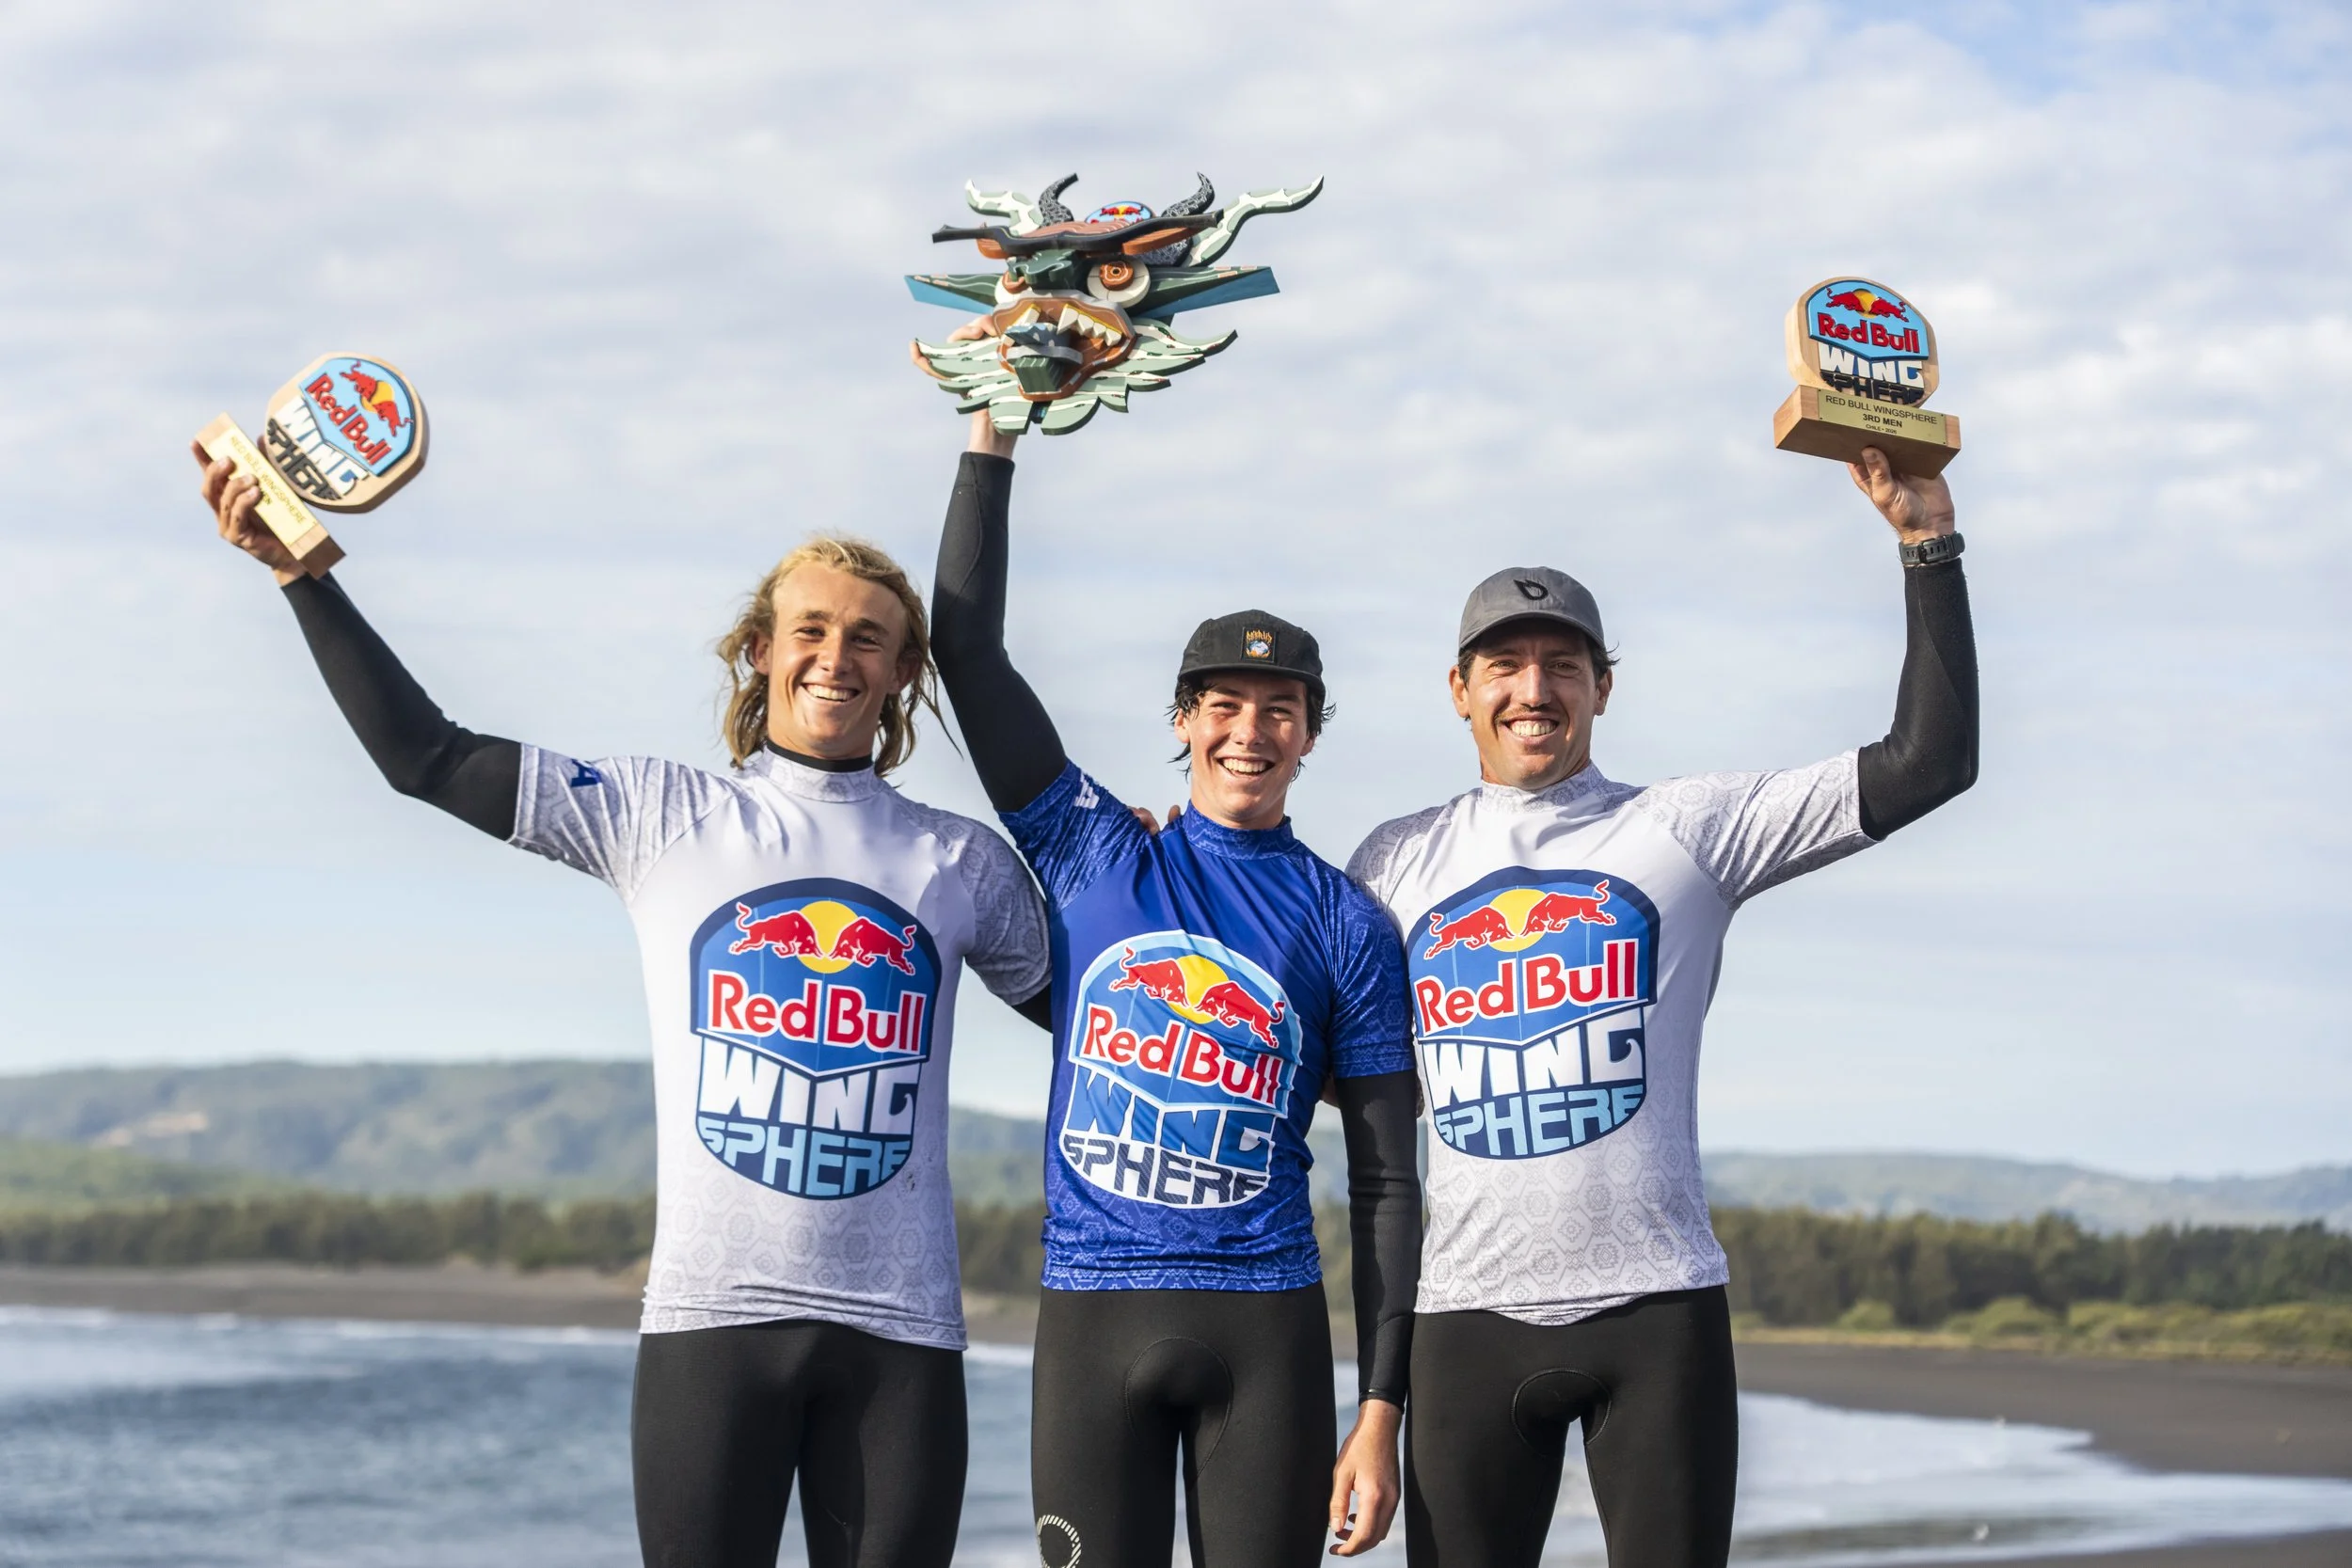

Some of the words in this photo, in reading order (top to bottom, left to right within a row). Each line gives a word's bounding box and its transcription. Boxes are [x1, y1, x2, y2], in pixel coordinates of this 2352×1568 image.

[1818, 312, 1869, 344] Red
[1870, 322, 1920, 354] Bull
[1819, 341, 1925, 388] WING
[274, 394, 370, 496] WING
[305, 372, 358, 426] Red
[340, 413, 392, 466] Bull
[1825, 395, 1846, 406] RED
[1848, 400, 1871, 412] BULL
[1873, 404, 1938, 425] WINGSPHERE
[1863, 414, 1881, 423] 3RD
[1883, 417, 1902, 428] MEN
[710, 973, 819, 1040] Red
[826, 987, 924, 1053] Bull
[1415, 961, 1516, 1034] Red
[1525, 941, 1636, 1009] Bull
[699, 1037, 921, 1135] WING
[1083, 1006, 1182, 1073] Red
[1181, 1032, 1283, 1104] Bull
[1422, 1007, 1643, 1111] WING
[698, 1117, 911, 1196] SPHERE
[1067, 1065, 1277, 1173] WING
[1435, 1085, 1644, 1156] SPHERE
